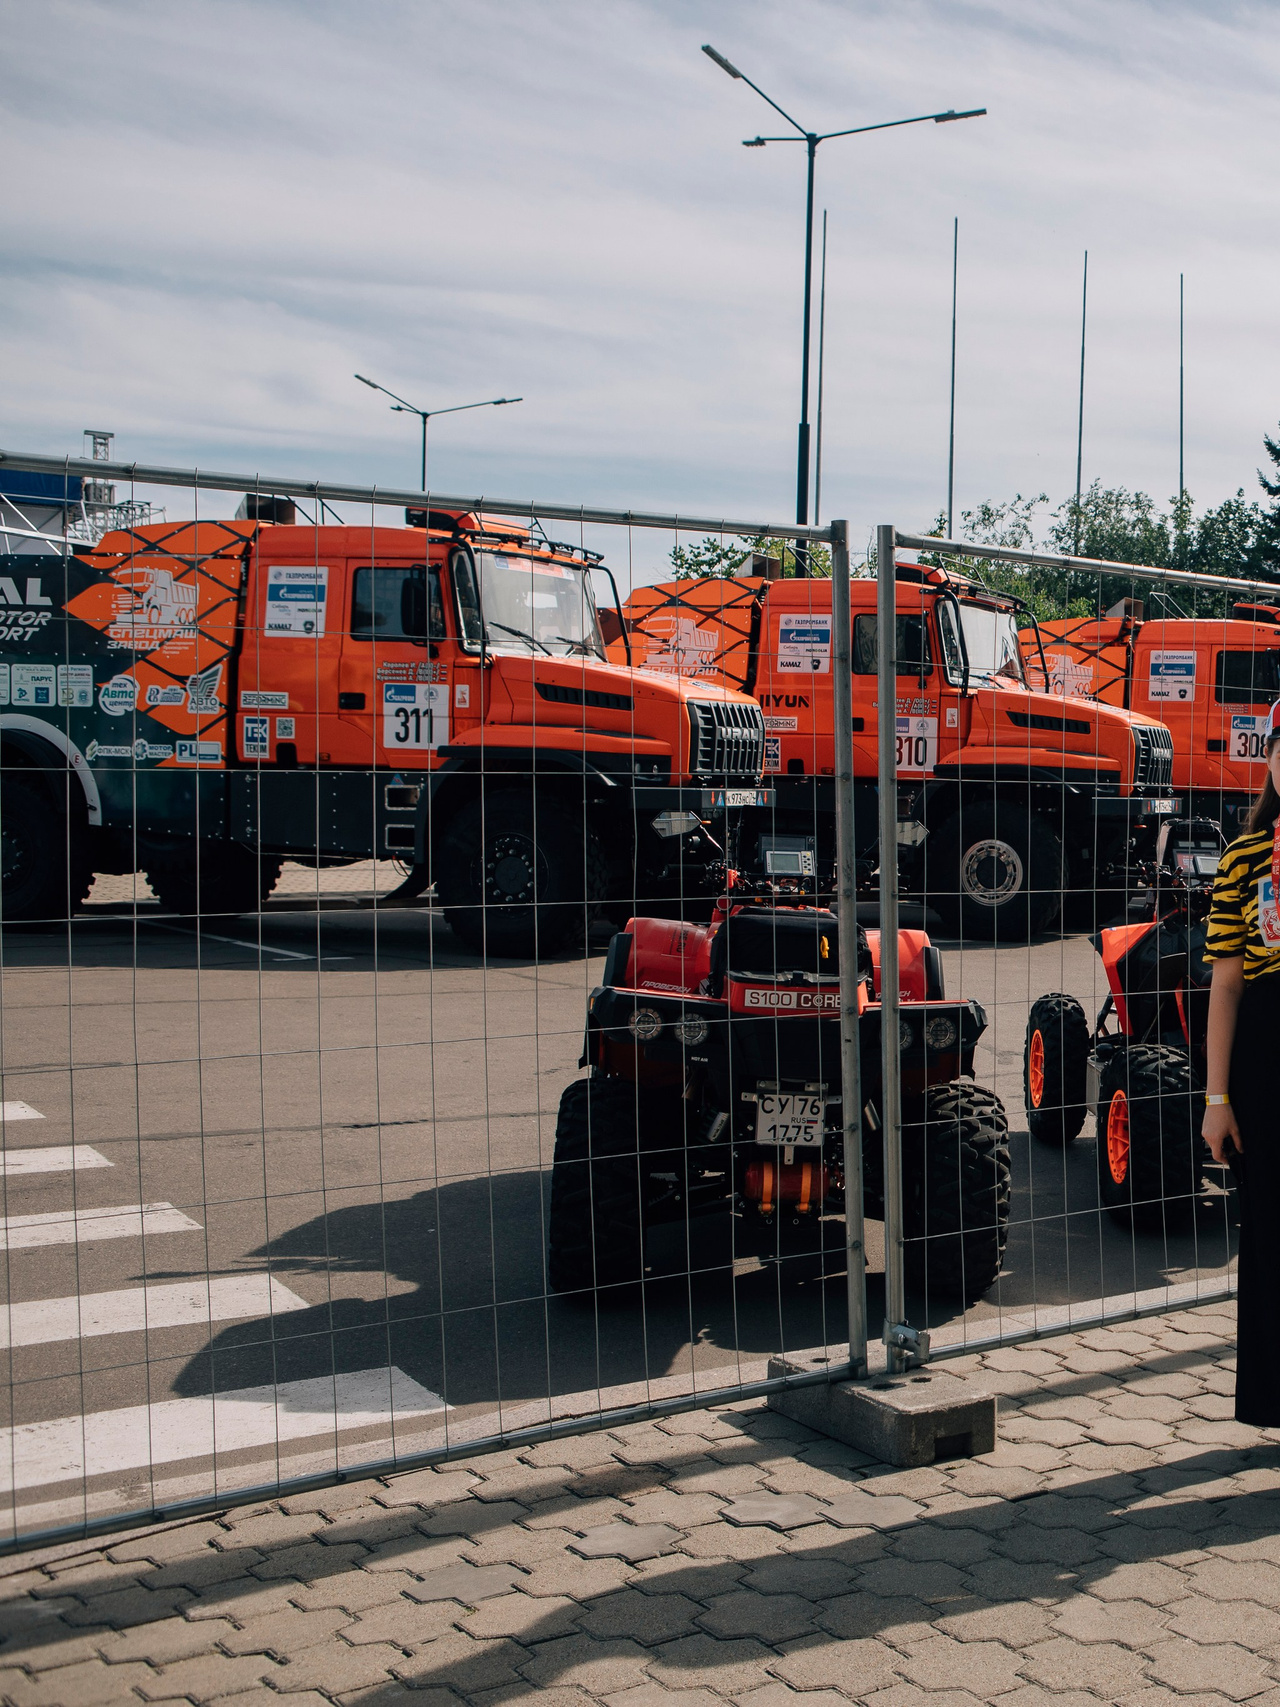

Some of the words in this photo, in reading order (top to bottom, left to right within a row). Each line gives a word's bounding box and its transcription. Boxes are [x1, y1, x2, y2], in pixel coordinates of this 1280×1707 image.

[109, 628, 197, 639] СПЕЦМАШ
[107, 640, 160, 651] ЗАВОД
[189, 698, 218, 706] АВТО
[394, 707, 433, 744] 311
[721, 727, 759, 740] URAL
[641, 980, 692, 994] ПРОВЕРЕН
[750, 991, 793, 1007] S100
[798, 1097, 821, 1116] 76
[767, 1124, 814, 1142] 1775
